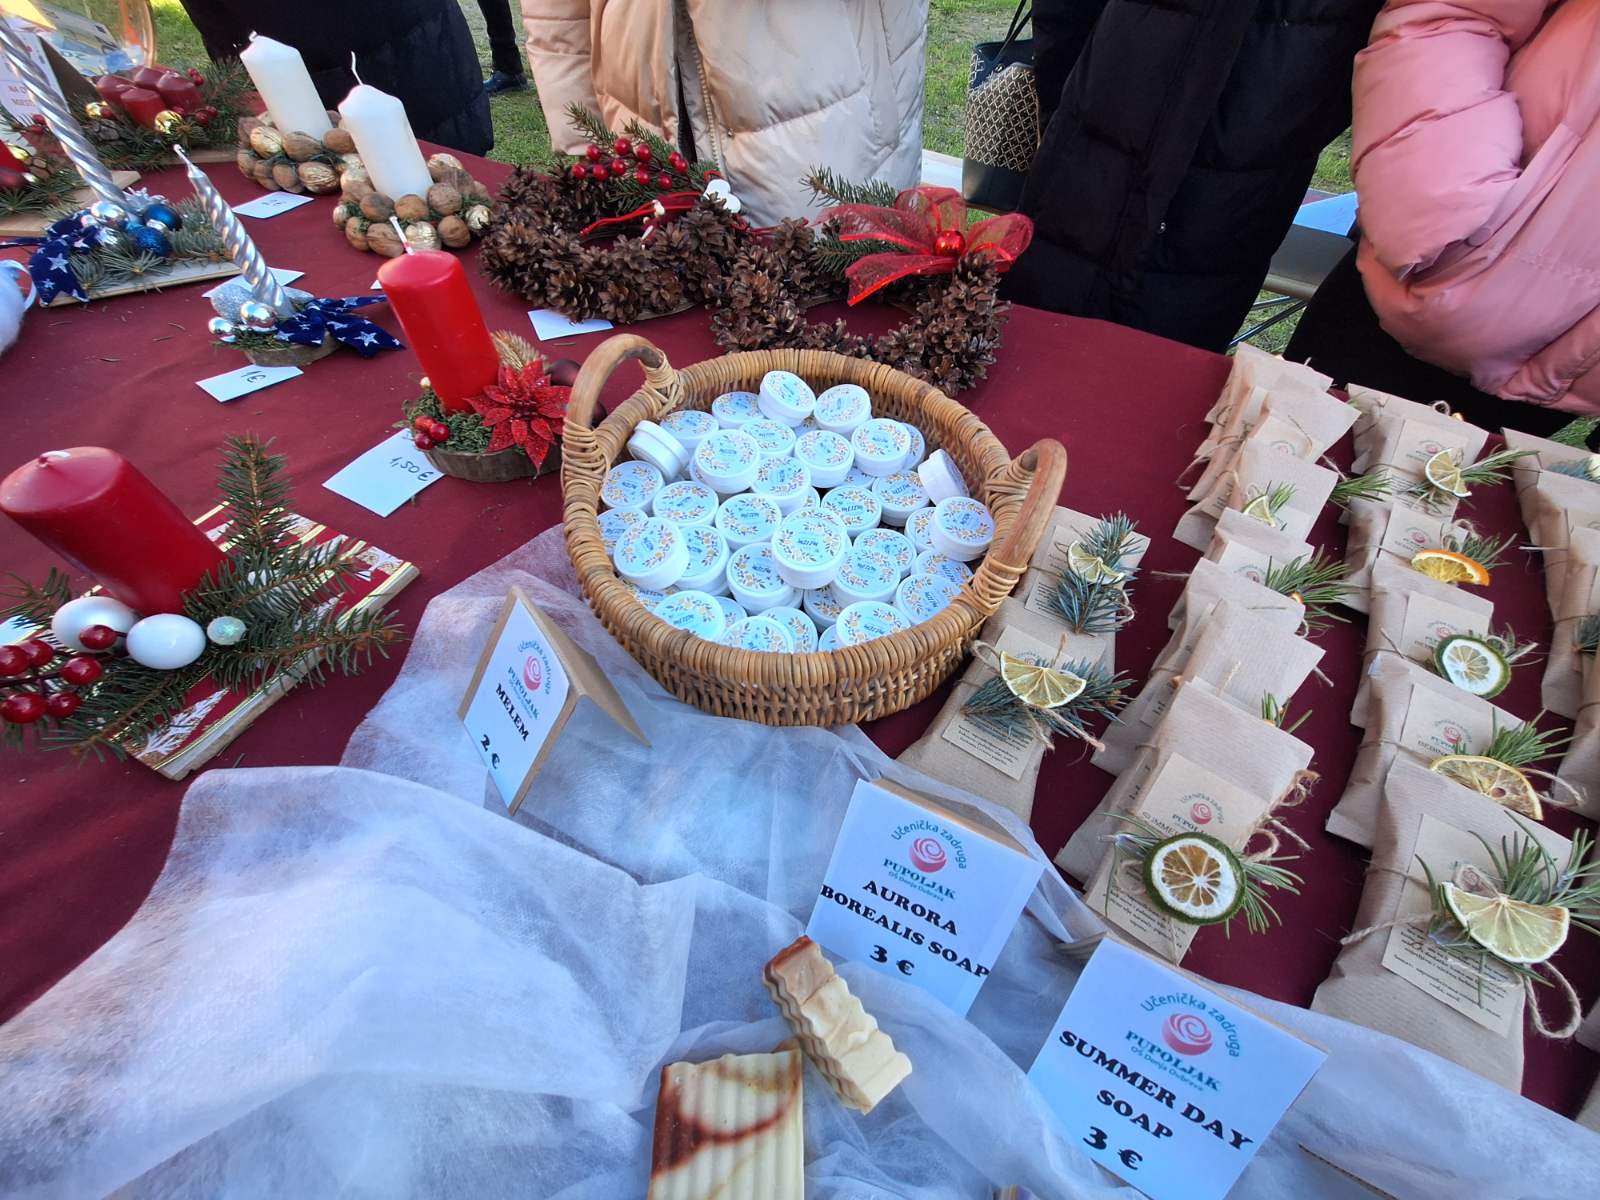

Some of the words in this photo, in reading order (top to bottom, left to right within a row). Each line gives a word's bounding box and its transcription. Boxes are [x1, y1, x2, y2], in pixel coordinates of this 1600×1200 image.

[495, 682, 530, 742] MELEM
[481, 734, 491, 752] 2
[491, 752, 500, 770] €
[891, 819, 939, 841] Učenička
[940, 828, 967, 870] zadruga
[883, 858, 957, 900] PUPOLJAK
[820, 884, 925, 945] BOREALIS
[928, 941, 990, 978] SOAP
[862, 880, 958, 936] AURORA
[870, 944, 888, 963] 3
[896, 959, 915, 976] €
[1141, 992, 1206, 1012] Učenička
[1208, 1007, 1240, 1058] zadruga
[1125, 1030, 1220, 1091] PUPOLJAK
[1059, 1030, 1177, 1109] SUMMER
[1180, 1102, 1254, 1151] DAY
[1096, 1089, 1174, 1139] SOAP
[1082, 1126, 1109, 1150] 3
[1117, 1148, 1143, 1170] €
